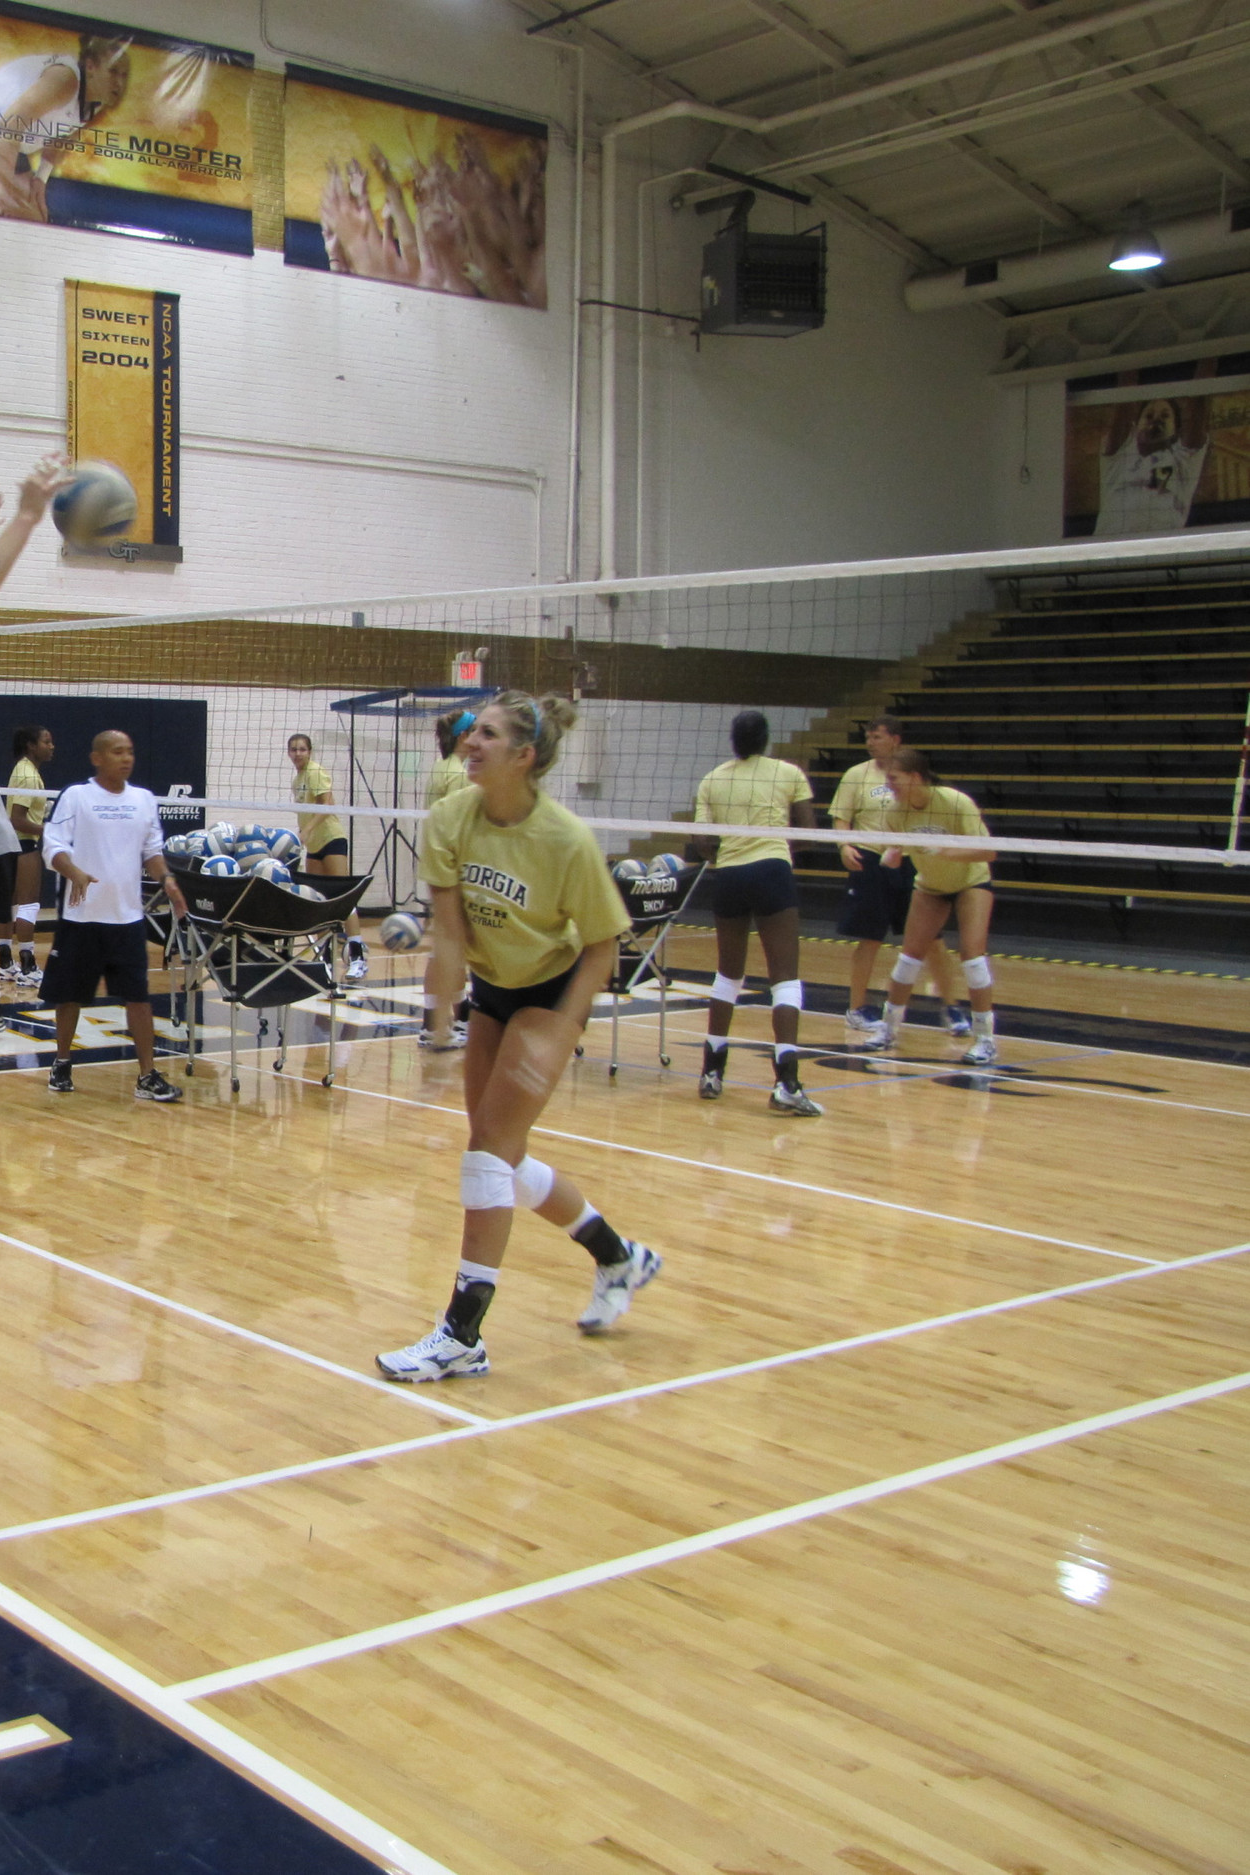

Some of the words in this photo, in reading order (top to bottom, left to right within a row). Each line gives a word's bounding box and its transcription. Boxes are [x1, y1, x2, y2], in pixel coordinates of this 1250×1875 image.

[43, 138, 86, 152] 2003
[94, 147, 134, 162] 2004
[137, 155, 242, 181] ALL-AMERICAN
[129, 135, 242, 170] MOSTER
[82, 307, 150, 326] SWEET
[82, 330, 150, 347] SIXTEEN
[162, 303, 172, 359] NCAA
[81, 350, 150, 370] 2004
[162, 366, 172, 517] TOURNAMENT
[158, 806, 201, 815] RUSSELL
[459, 864, 527, 908] EORGIA
[468, 901, 508, 919] ECH
